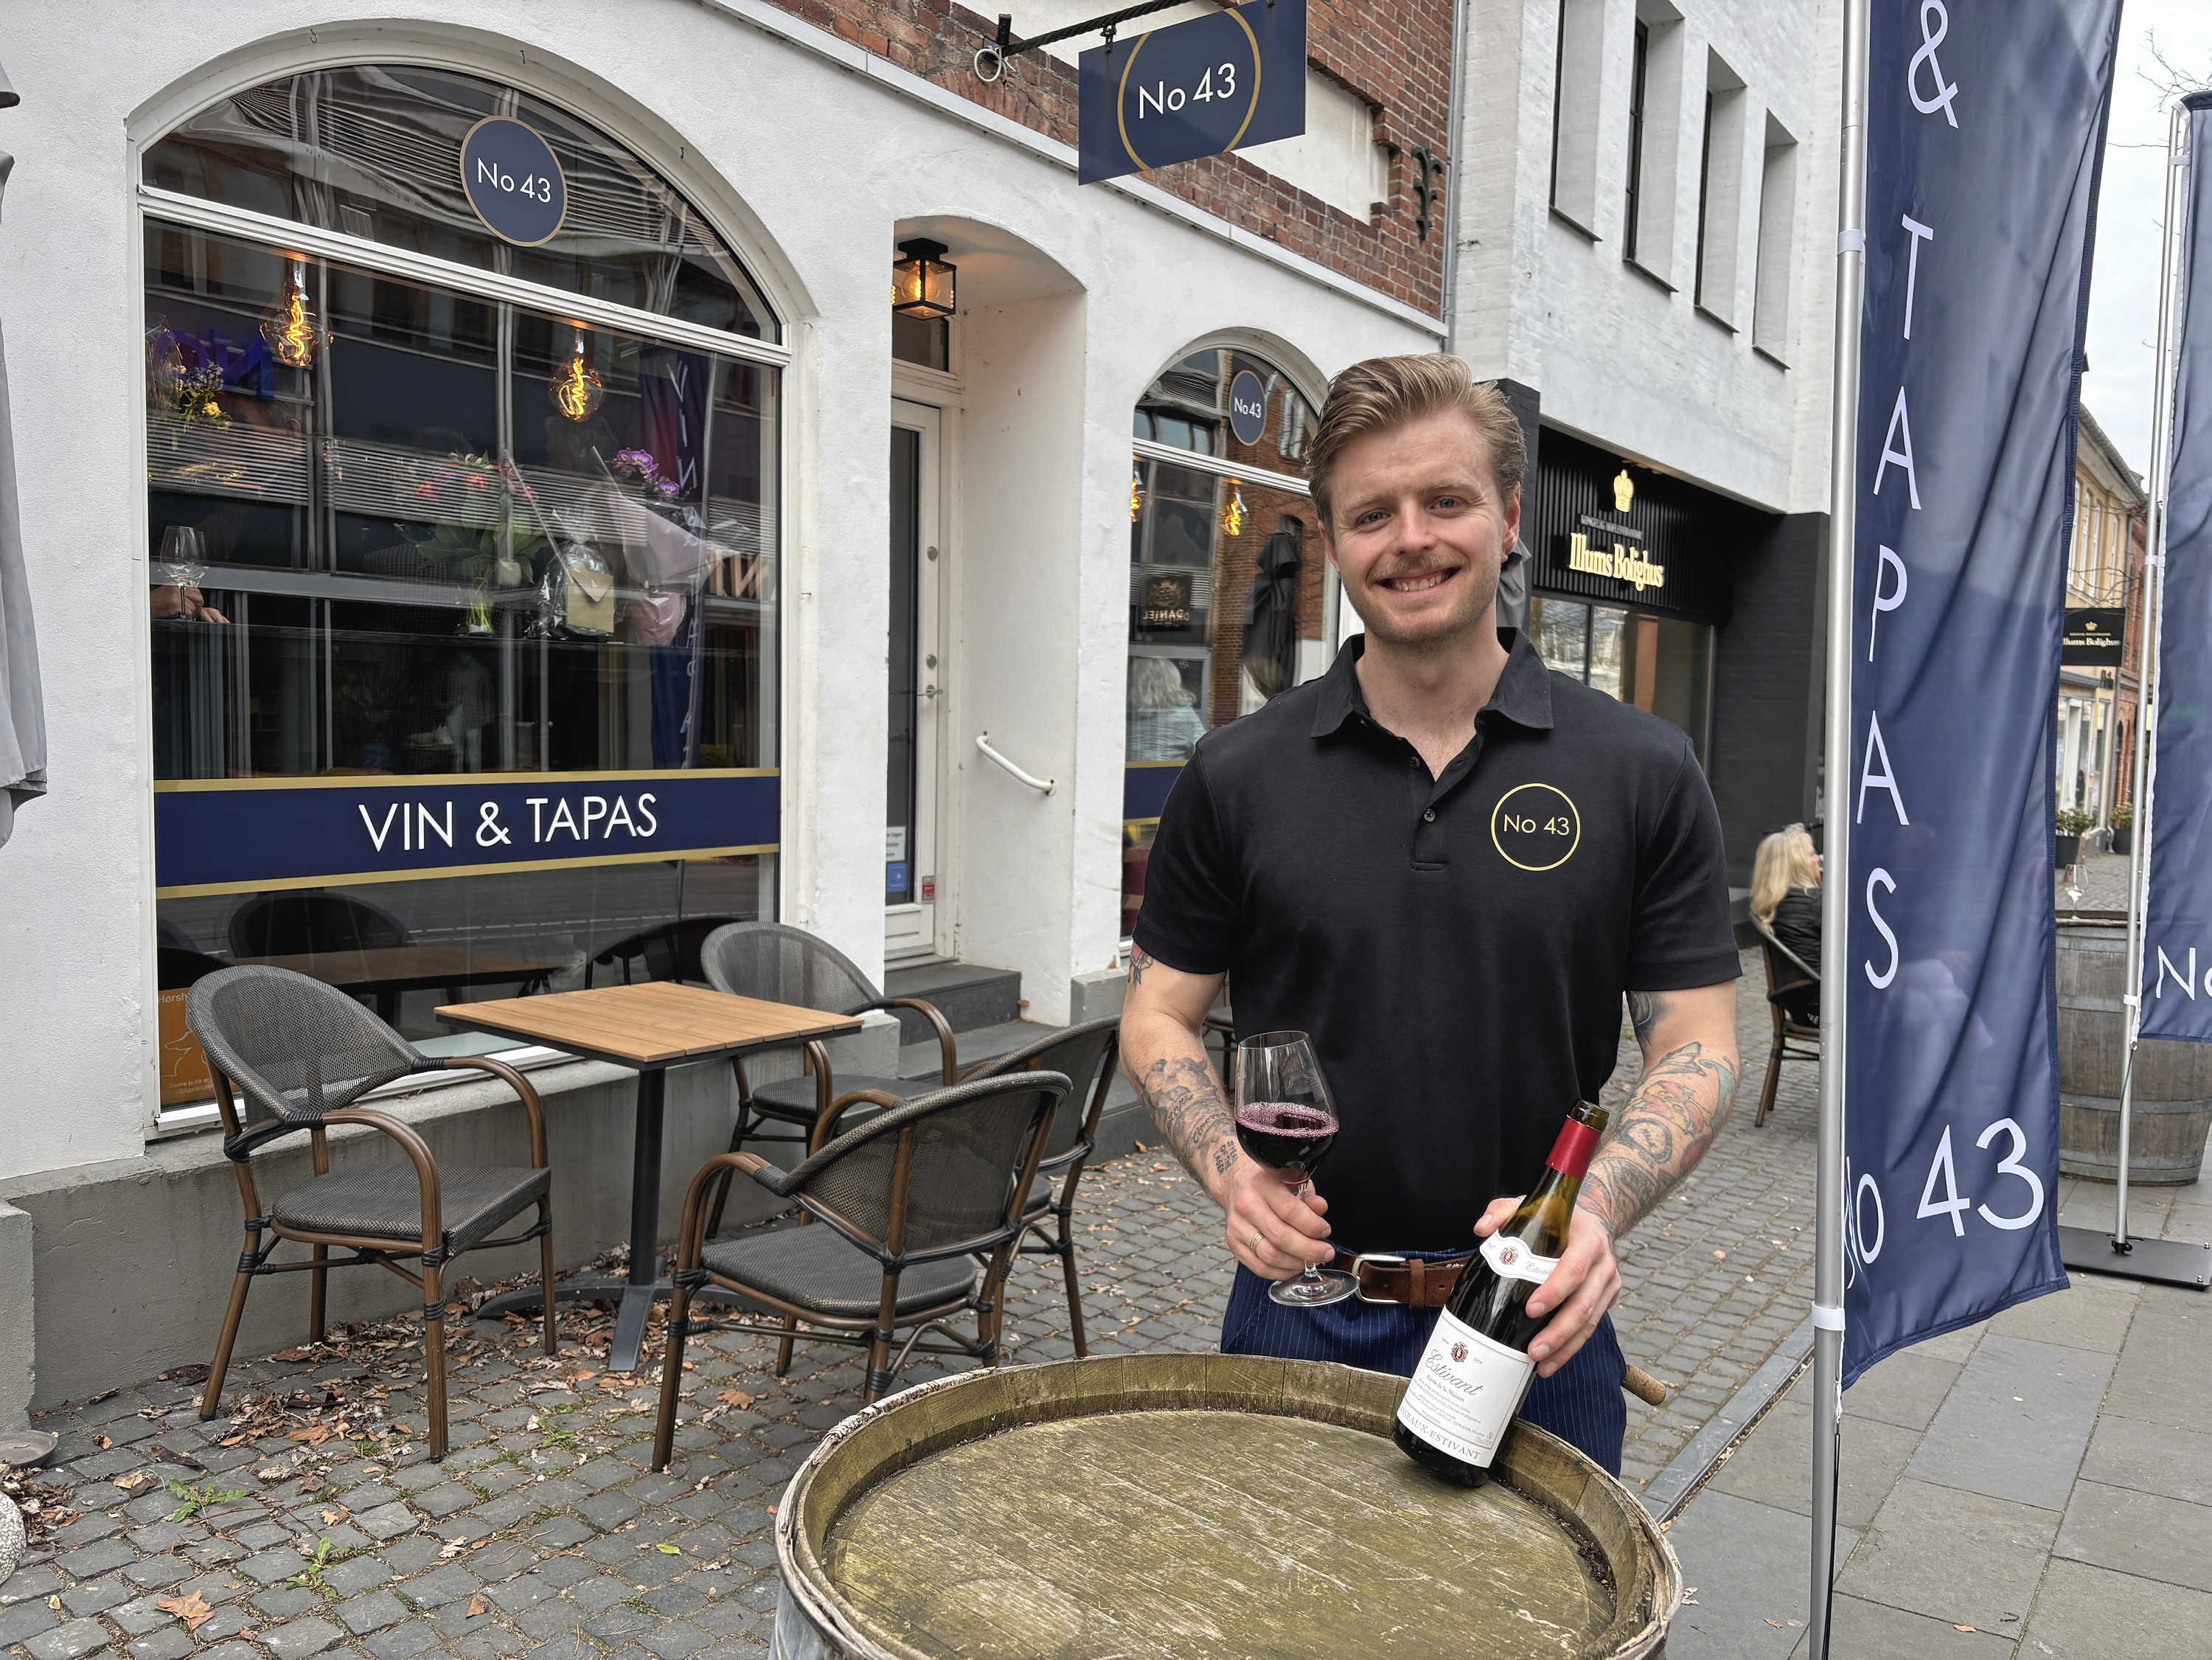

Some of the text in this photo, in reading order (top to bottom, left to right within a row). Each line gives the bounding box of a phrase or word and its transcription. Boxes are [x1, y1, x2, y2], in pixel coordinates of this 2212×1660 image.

[1139, 63, 1236, 119] No 43
[478, 157, 551, 203] No 43
[1234, 397, 1262, 419] No 43
[1857, 0, 1959, 989] & TAPAS
[1569, 532, 1664, 591] Illums Bolighus
[358, 793, 658, 852] VIN & TAPAS
[1503, 813, 1571, 836] No 43
[2156, 945, 2212, 1001] N
[1916, 1117, 2045, 1237] 43
[1425, 1349, 1484, 1395] Estivant
